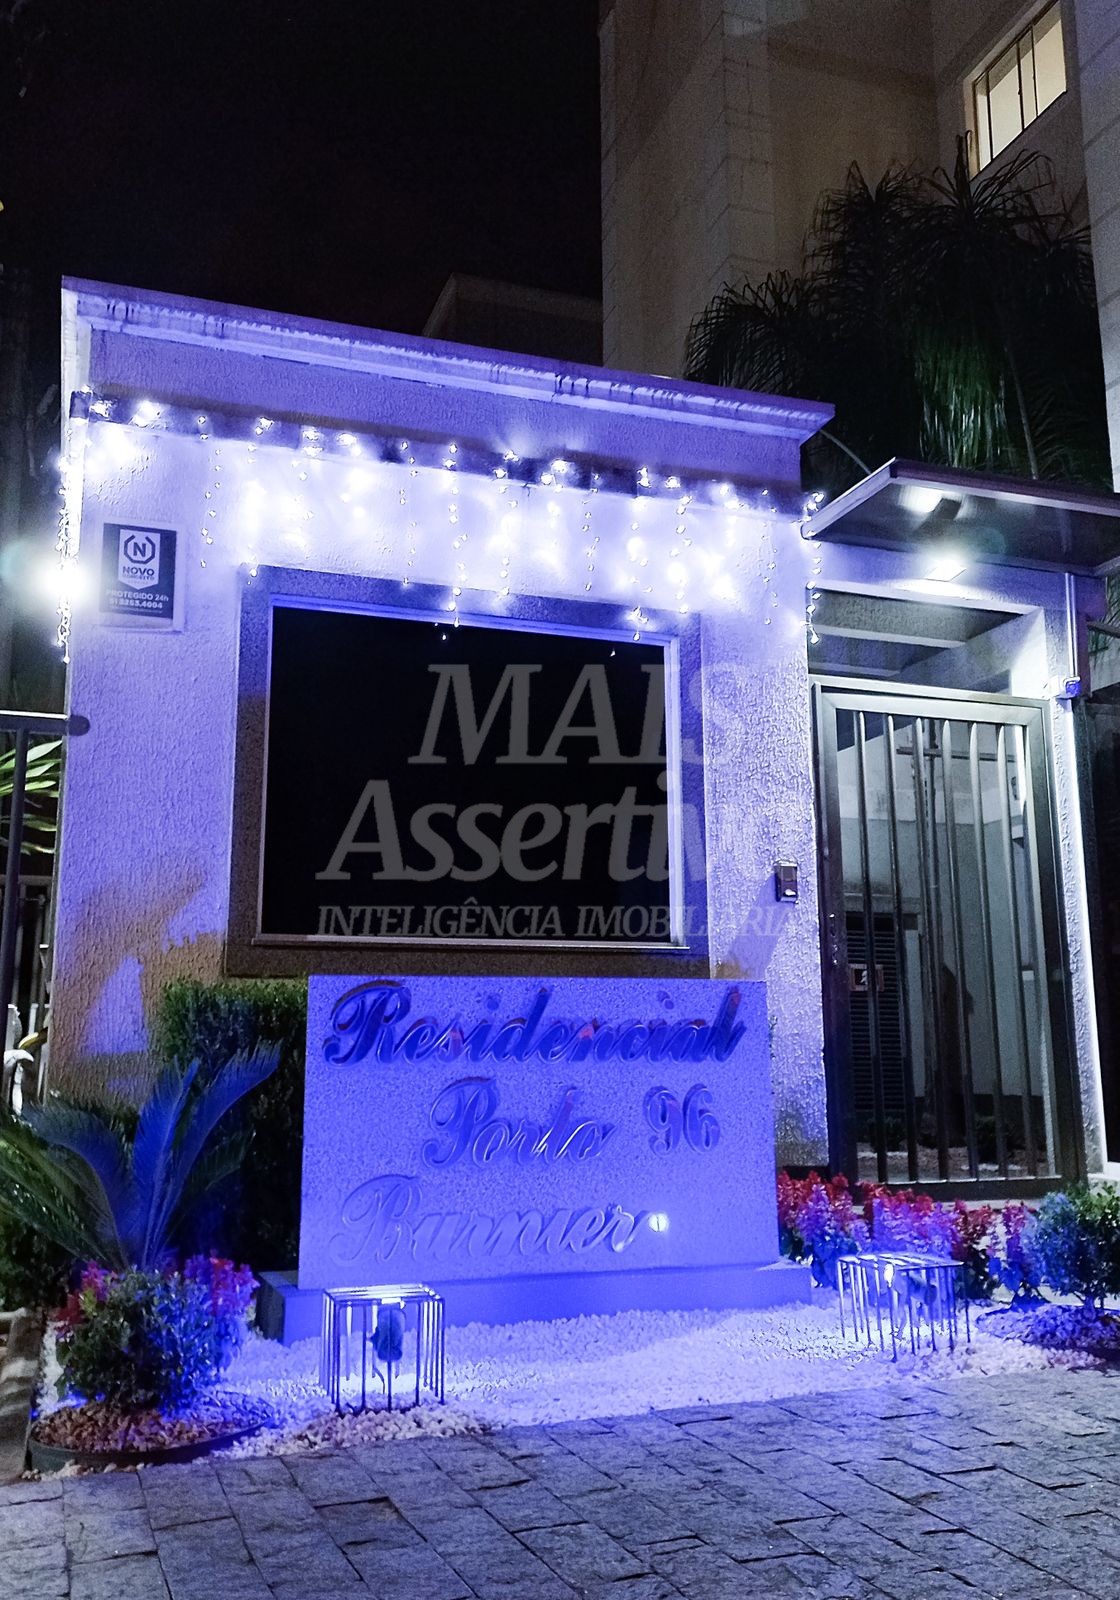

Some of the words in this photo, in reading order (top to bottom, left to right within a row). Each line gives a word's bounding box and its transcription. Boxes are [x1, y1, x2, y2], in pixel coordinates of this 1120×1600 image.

[122, 566, 155, 577] NOVO
[323, 979, 747, 1067] Residencial
[422, 1076, 617, 1169] Porto
[643, 1083, 722, 1157] 96
